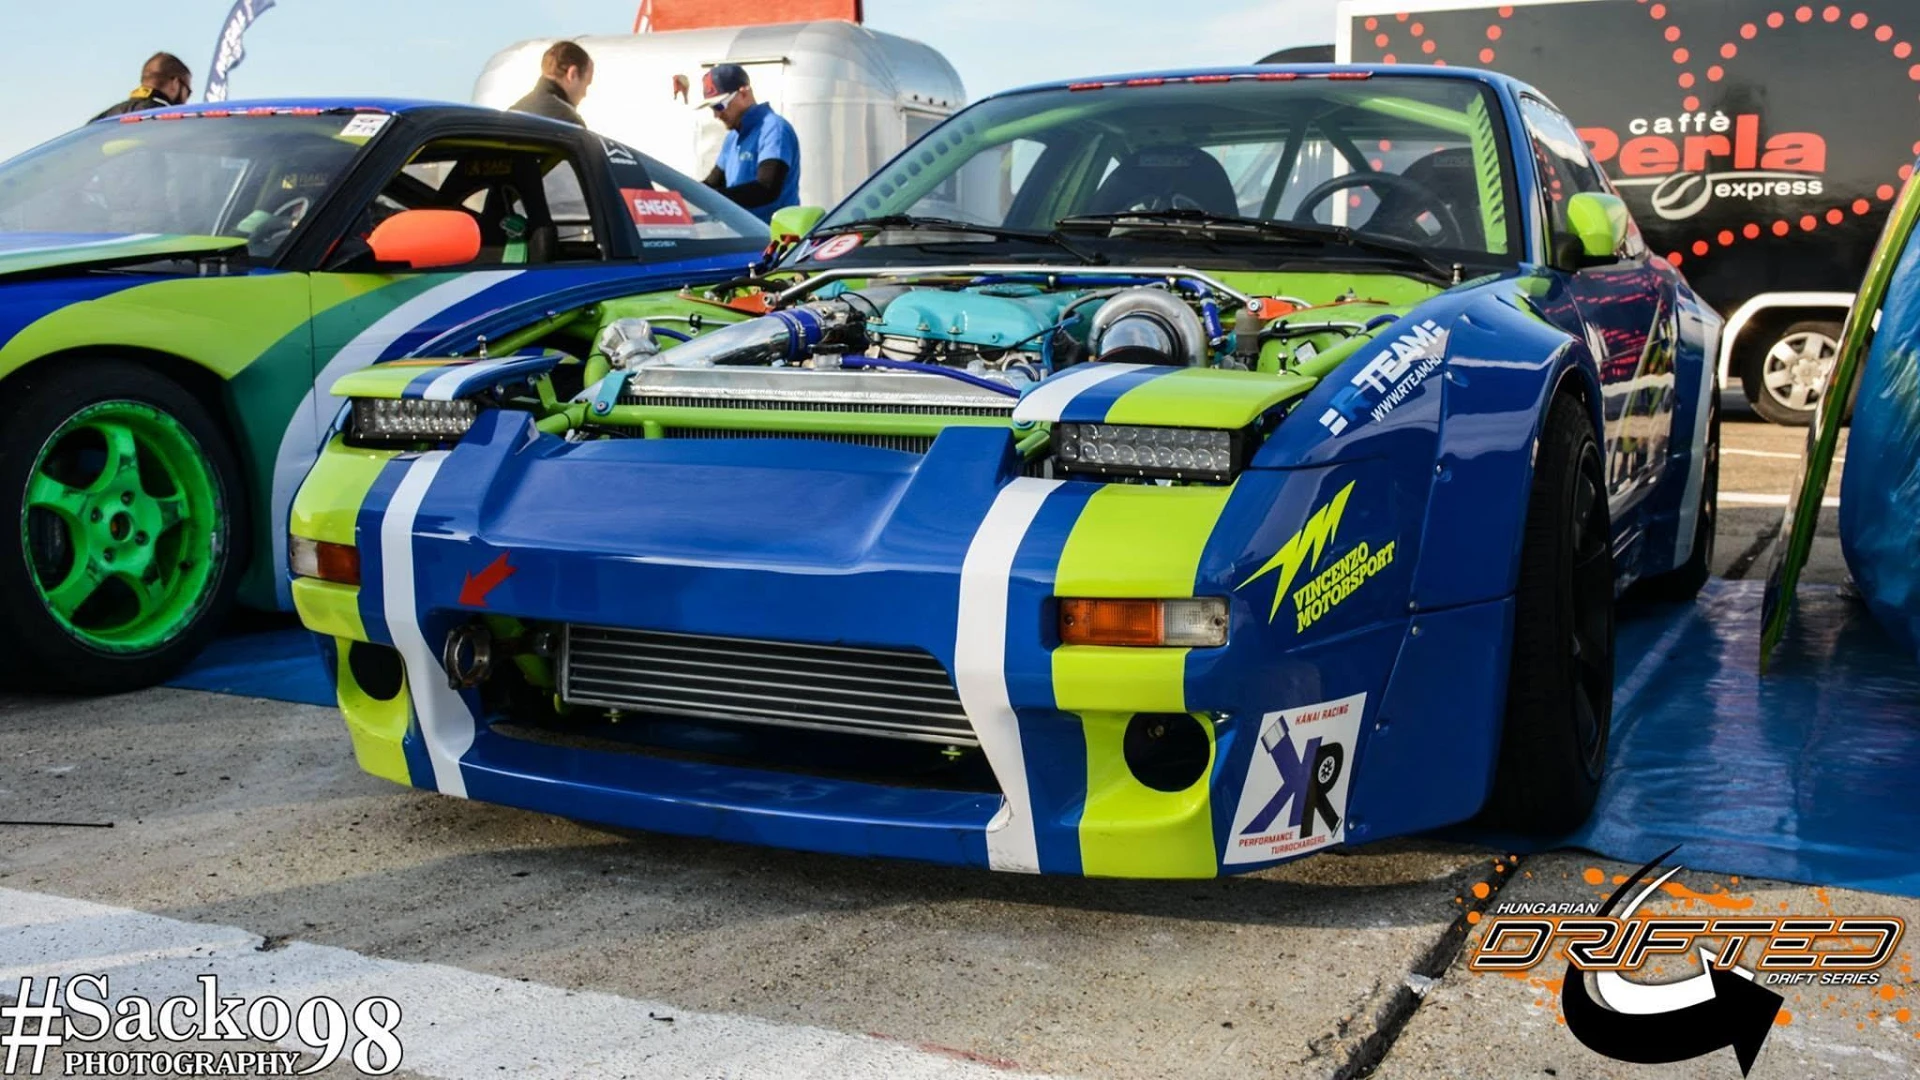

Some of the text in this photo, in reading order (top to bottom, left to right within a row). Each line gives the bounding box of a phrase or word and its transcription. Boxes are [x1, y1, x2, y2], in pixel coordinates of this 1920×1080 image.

[1629, 111, 1731, 135] caffè
[1714, 180, 1823, 200] express
[634, 198, 683, 217] ENEOS
[1293, 541, 1368, 612] VINCENZO
[1297, 540, 1395, 634] MOTORSPORT
[1323, 703, 1349, 718] RACING
[1239, 831, 1294, 847] PERFORMANCE
[1271, 834, 1326, 855] TURBOCHARGERS
